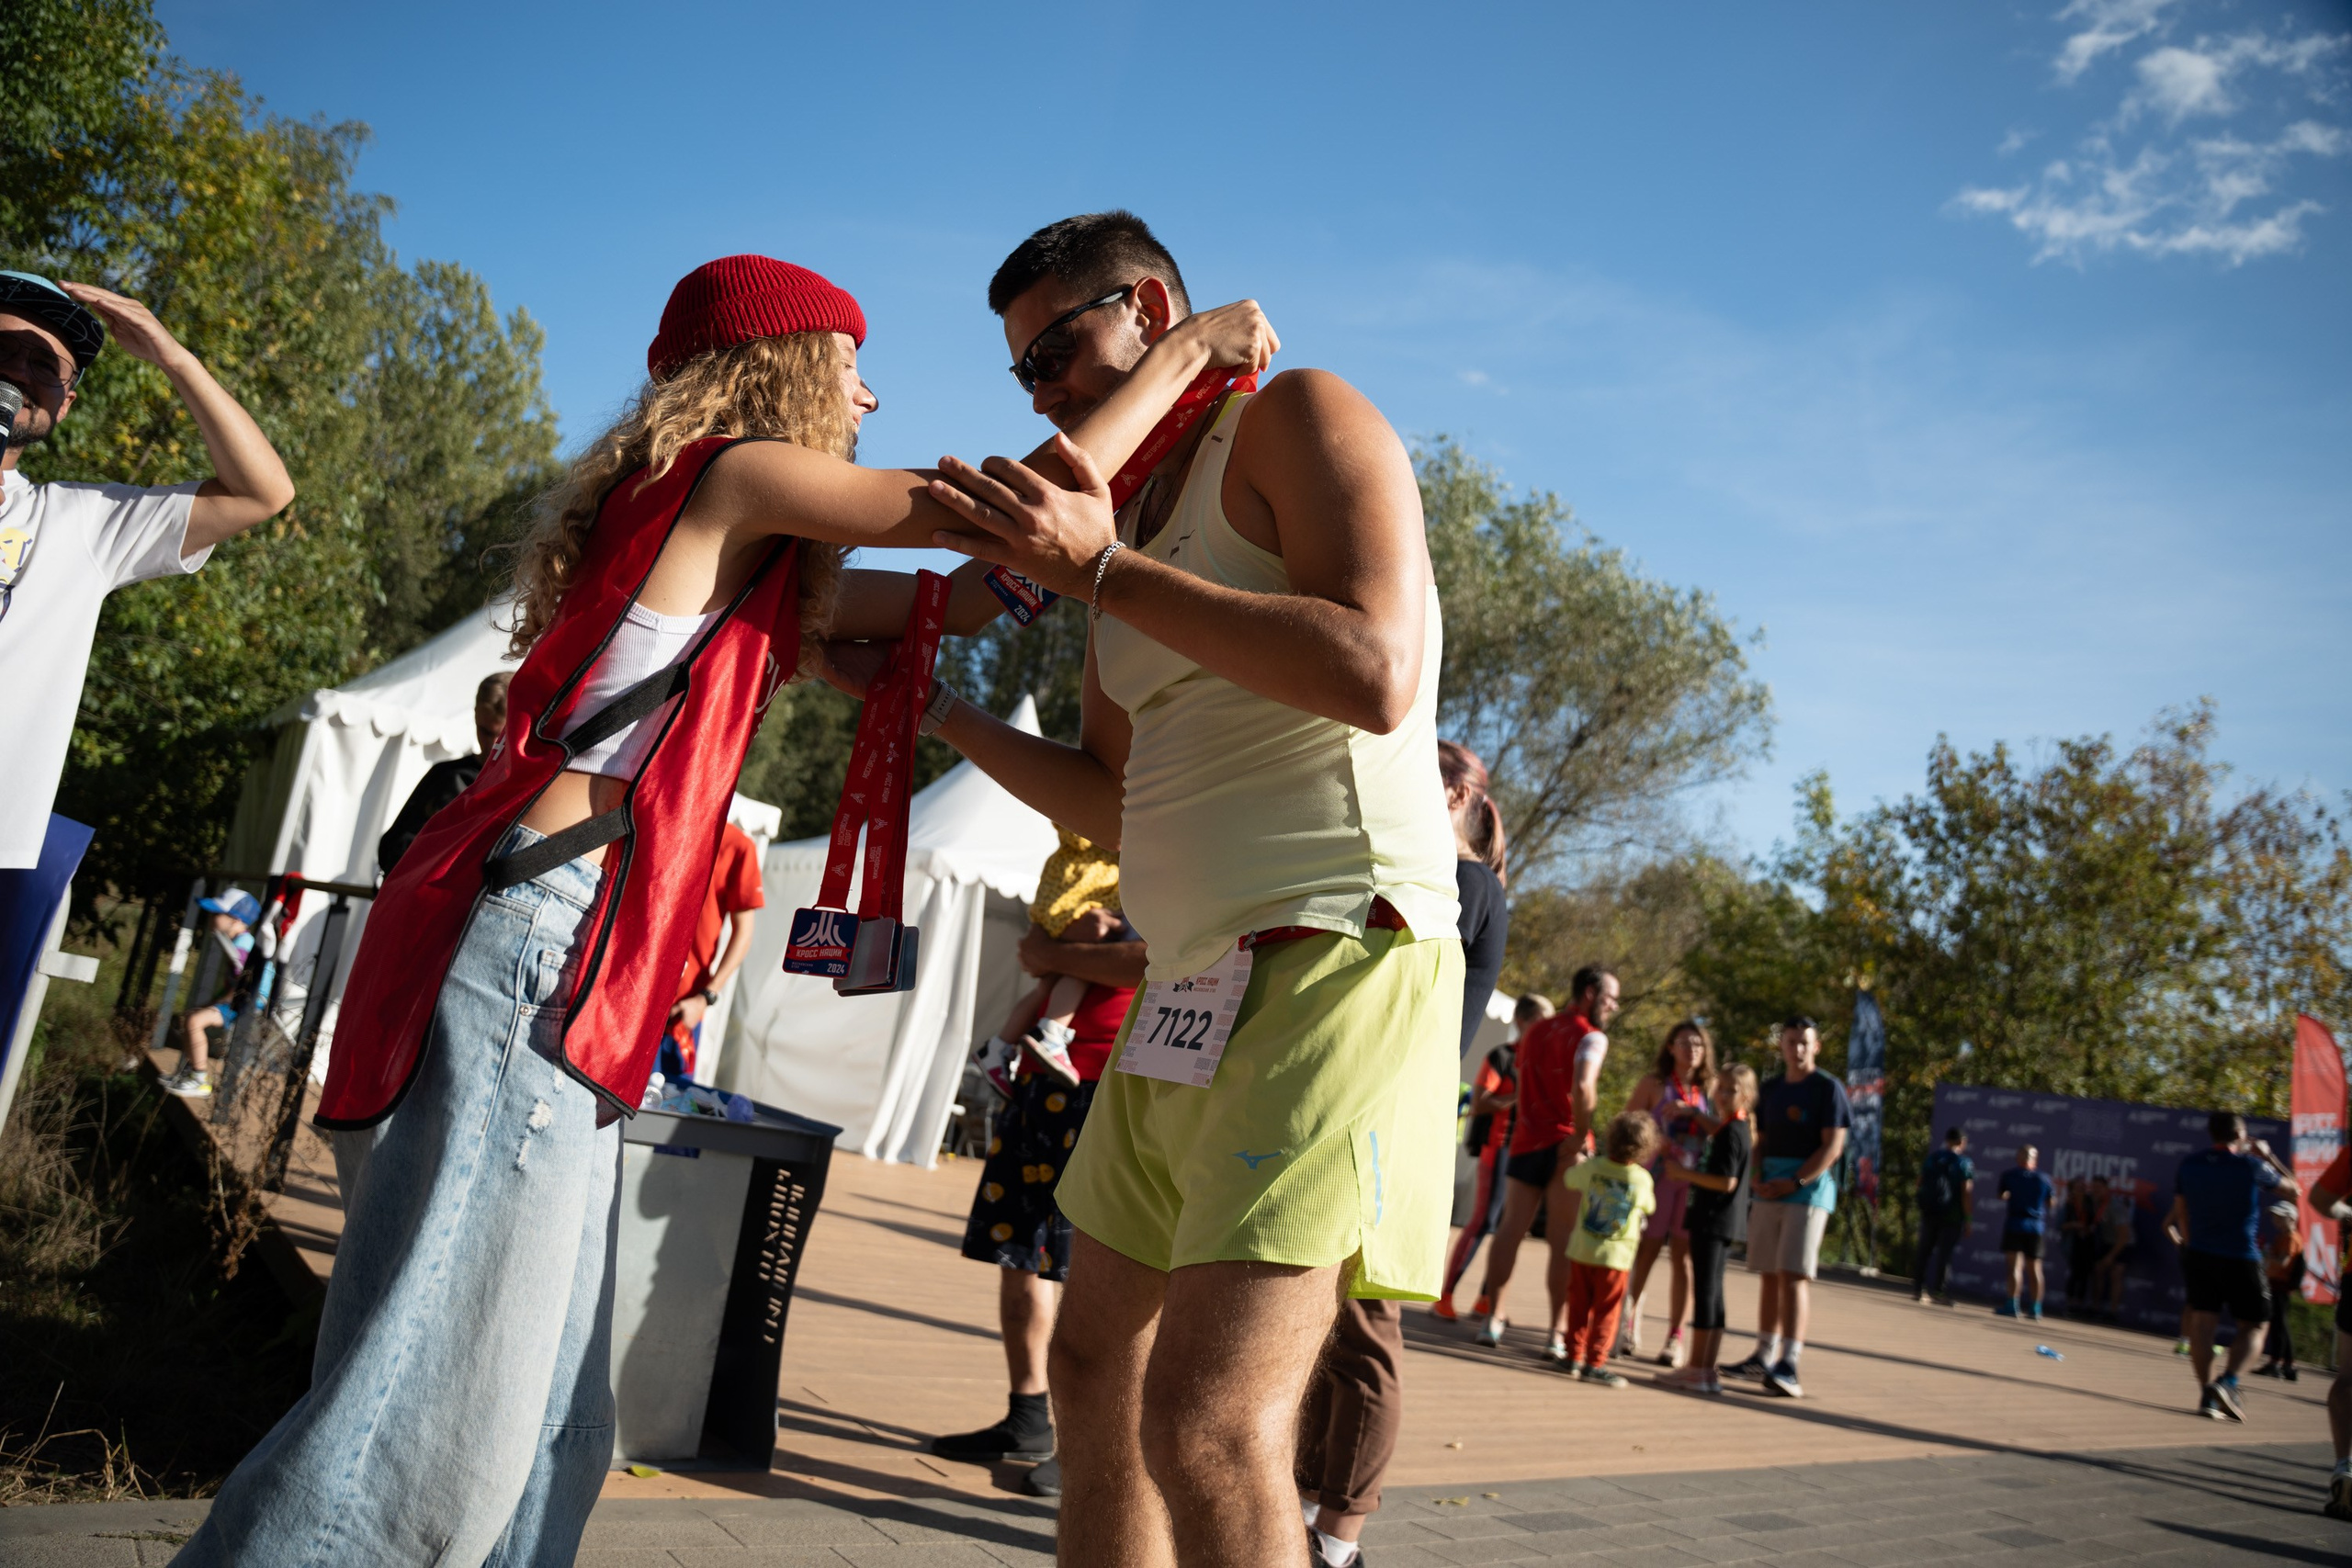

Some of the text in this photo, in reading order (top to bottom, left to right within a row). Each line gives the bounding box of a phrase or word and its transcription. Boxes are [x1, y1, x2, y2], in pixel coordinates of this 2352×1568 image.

[1000, 572, 1020, 591] КРОСС
[1017, 587, 1037, 607] НАЦИИ
[1013, 604, 1030, 623] 2024
[796, 948, 842, 958] КРОСС НАЦИИ
[827, 963, 845, 974] 2024
[1147, 1006, 1213, 1051] 7122
